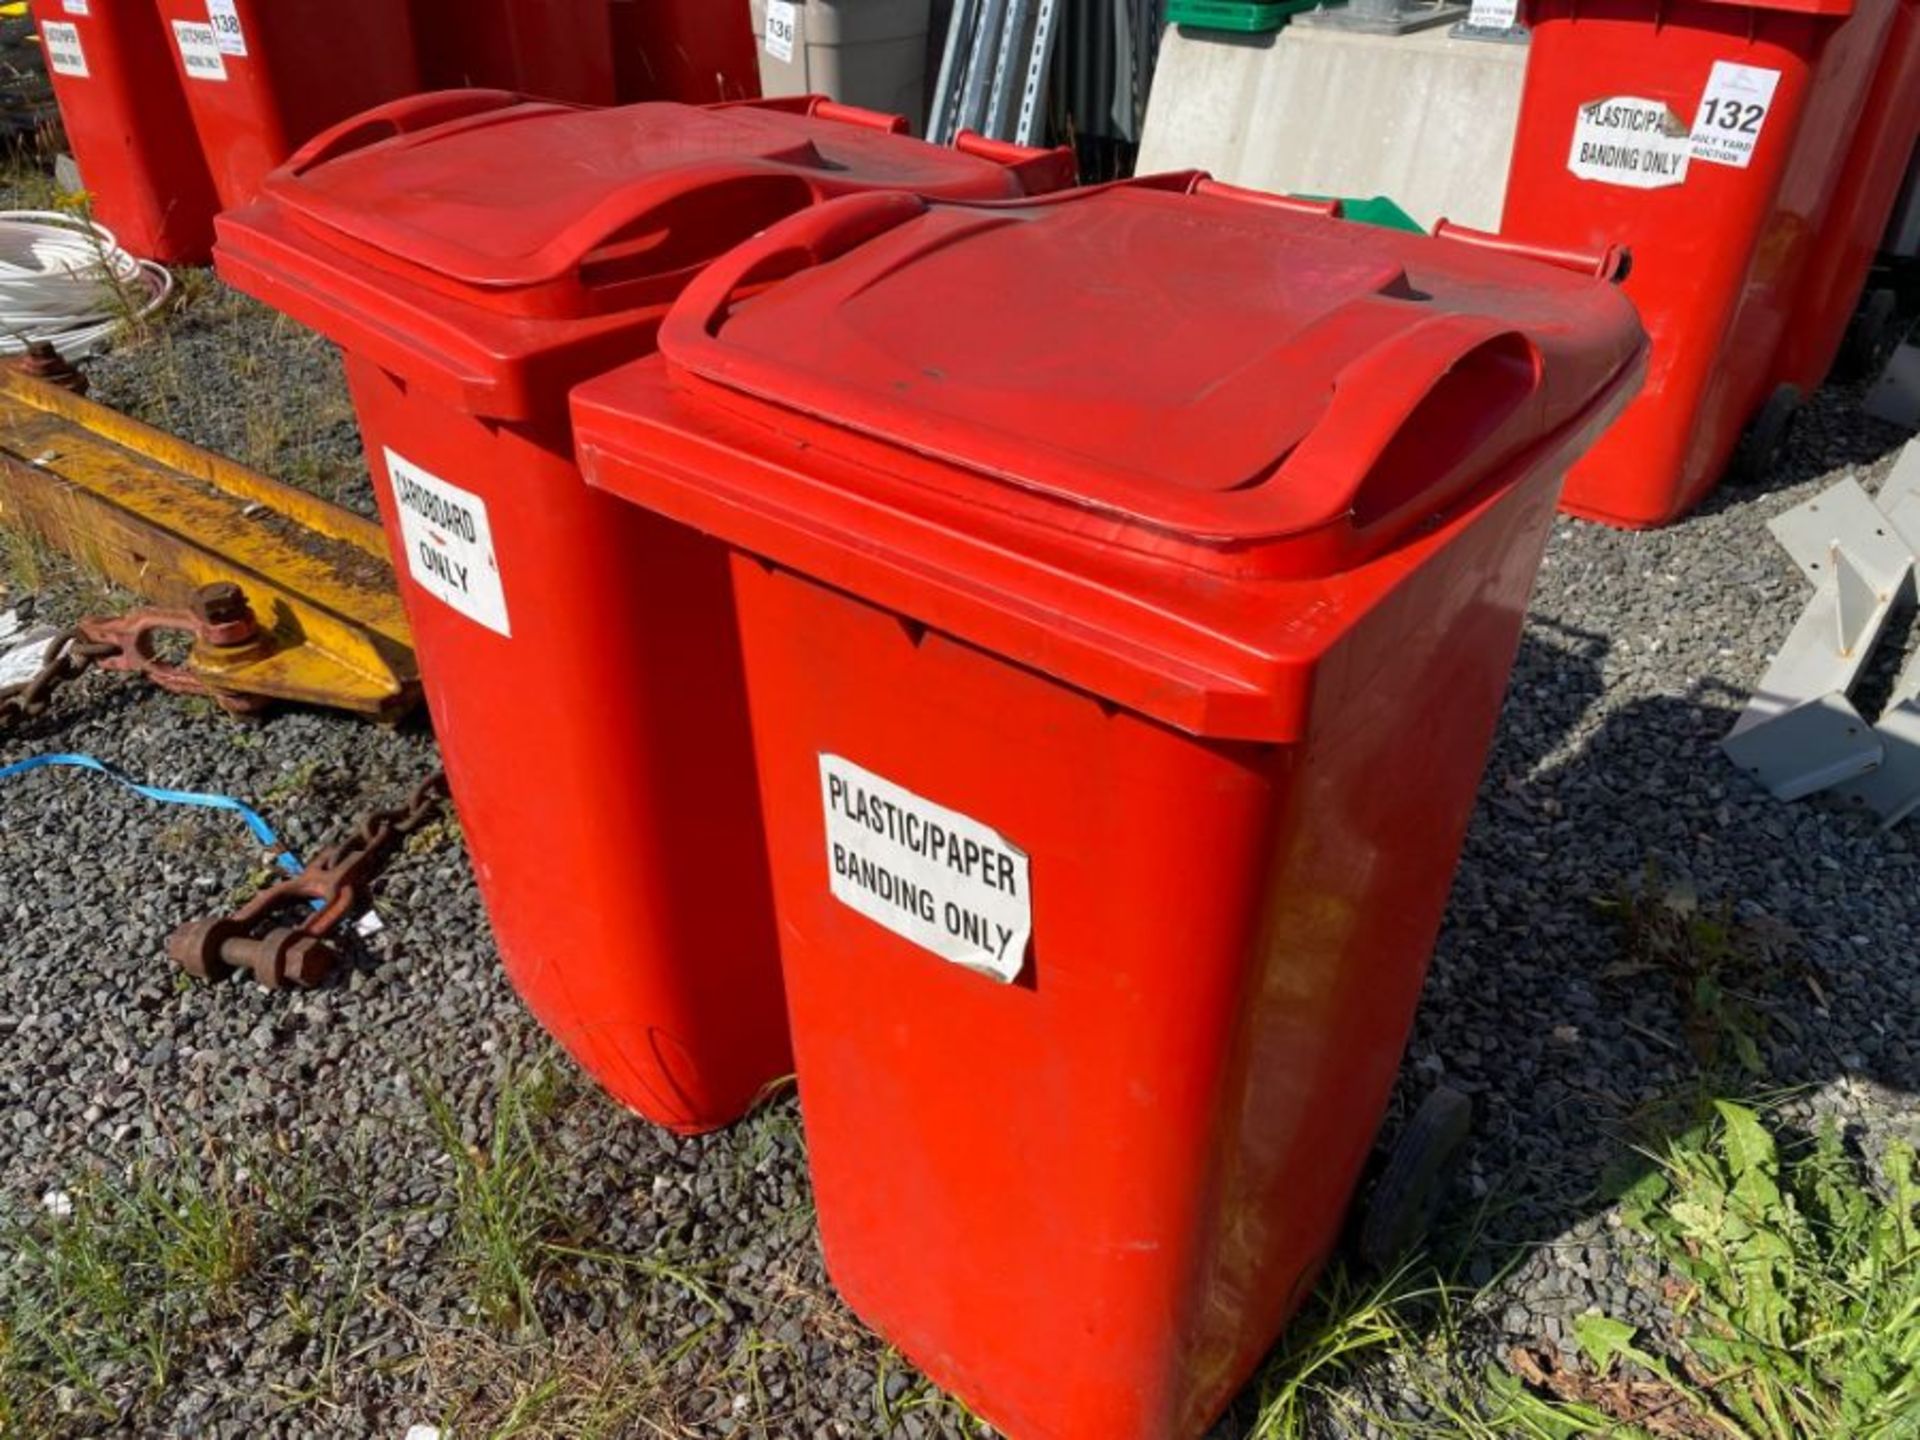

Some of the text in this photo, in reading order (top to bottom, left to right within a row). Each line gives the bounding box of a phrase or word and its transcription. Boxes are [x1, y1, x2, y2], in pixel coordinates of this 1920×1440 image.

[212, 13, 239, 34] 138
[768, 18, 792, 42] 136
[1586, 102, 1665, 134] PLASTIC/PA
[1704, 97, 1765, 133] 132
[1580, 141, 1682, 175] BANDING ONLY
[394, 470, 477, 545] CARDBOARD
[419, 541, 468, 594] ONLY
[828, 772, 1017, 897] PLASTIC/PAPER
[832, 842, 1013, 962] BANDING ONLY
